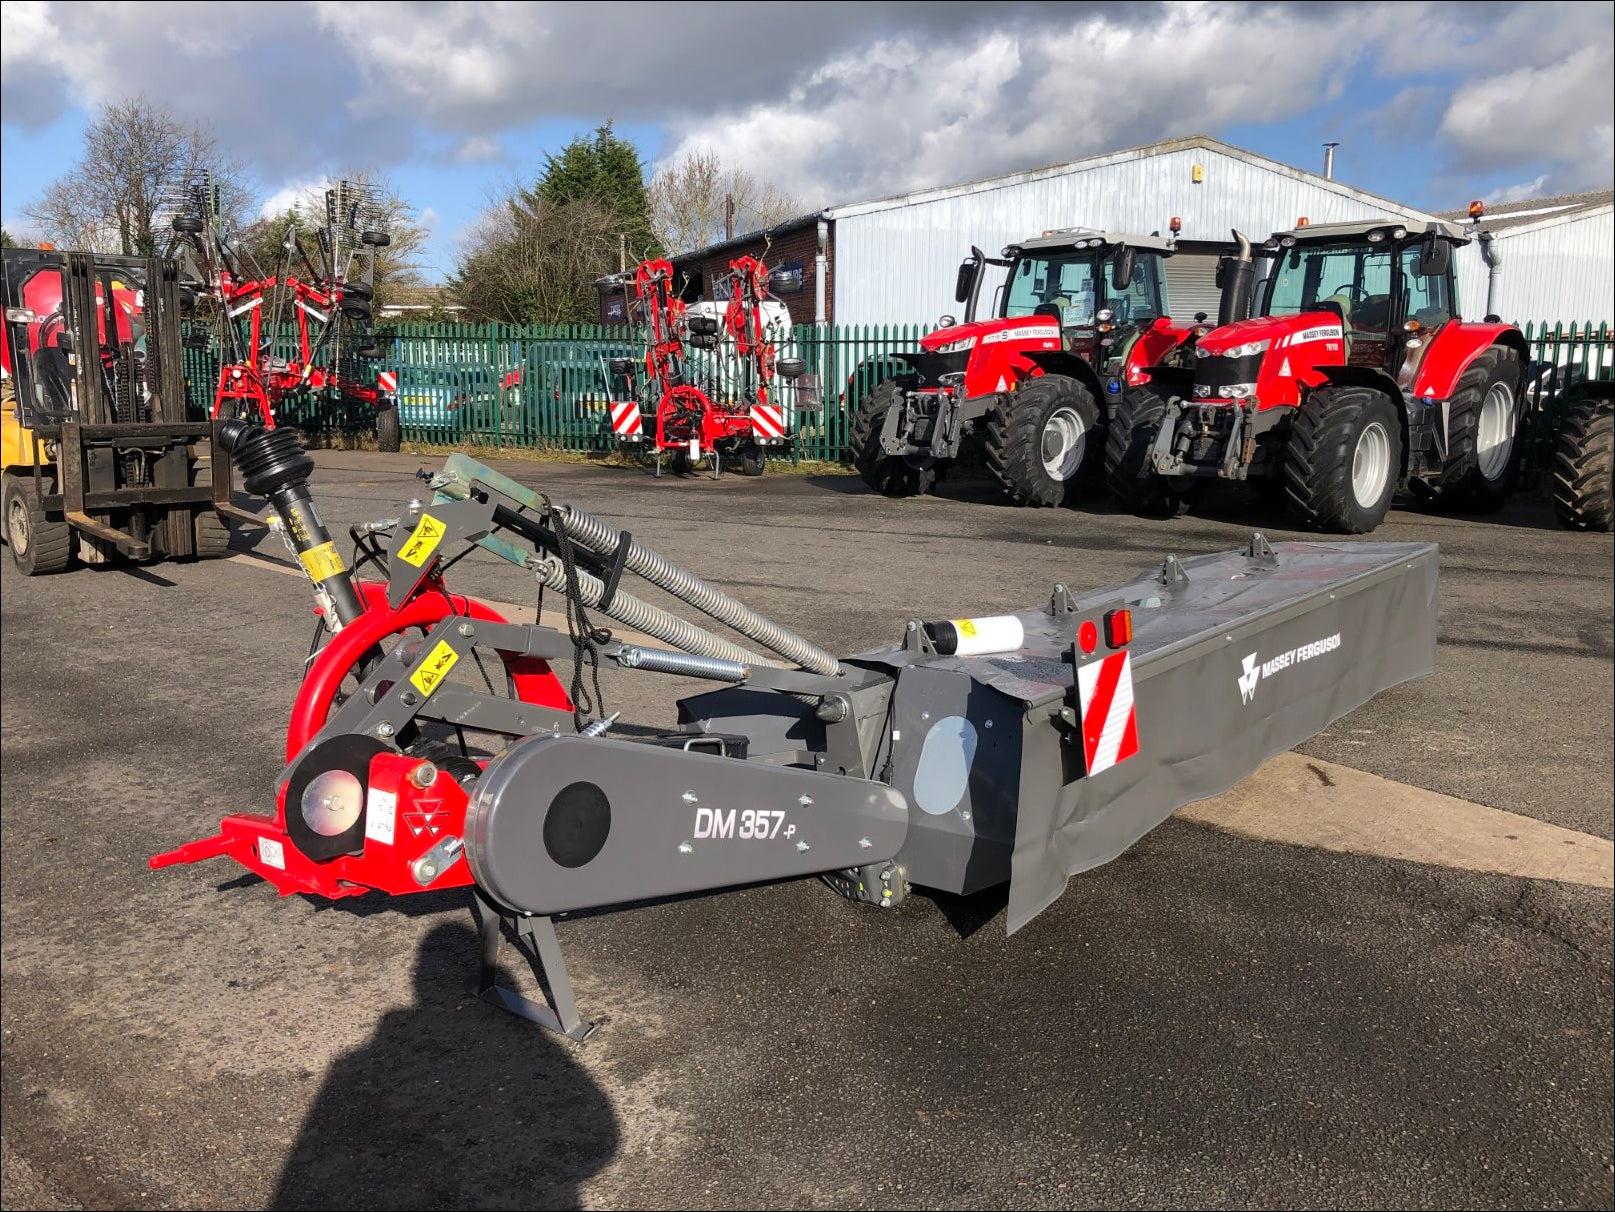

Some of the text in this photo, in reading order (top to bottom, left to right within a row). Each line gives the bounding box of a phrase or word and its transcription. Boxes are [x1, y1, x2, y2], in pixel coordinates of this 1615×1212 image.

[1302, 328, 1340, 340] MASSEY FERGUSON
[1262, 649, 1296, 679] MASSEY
[693, 808, 737, 839] DM
